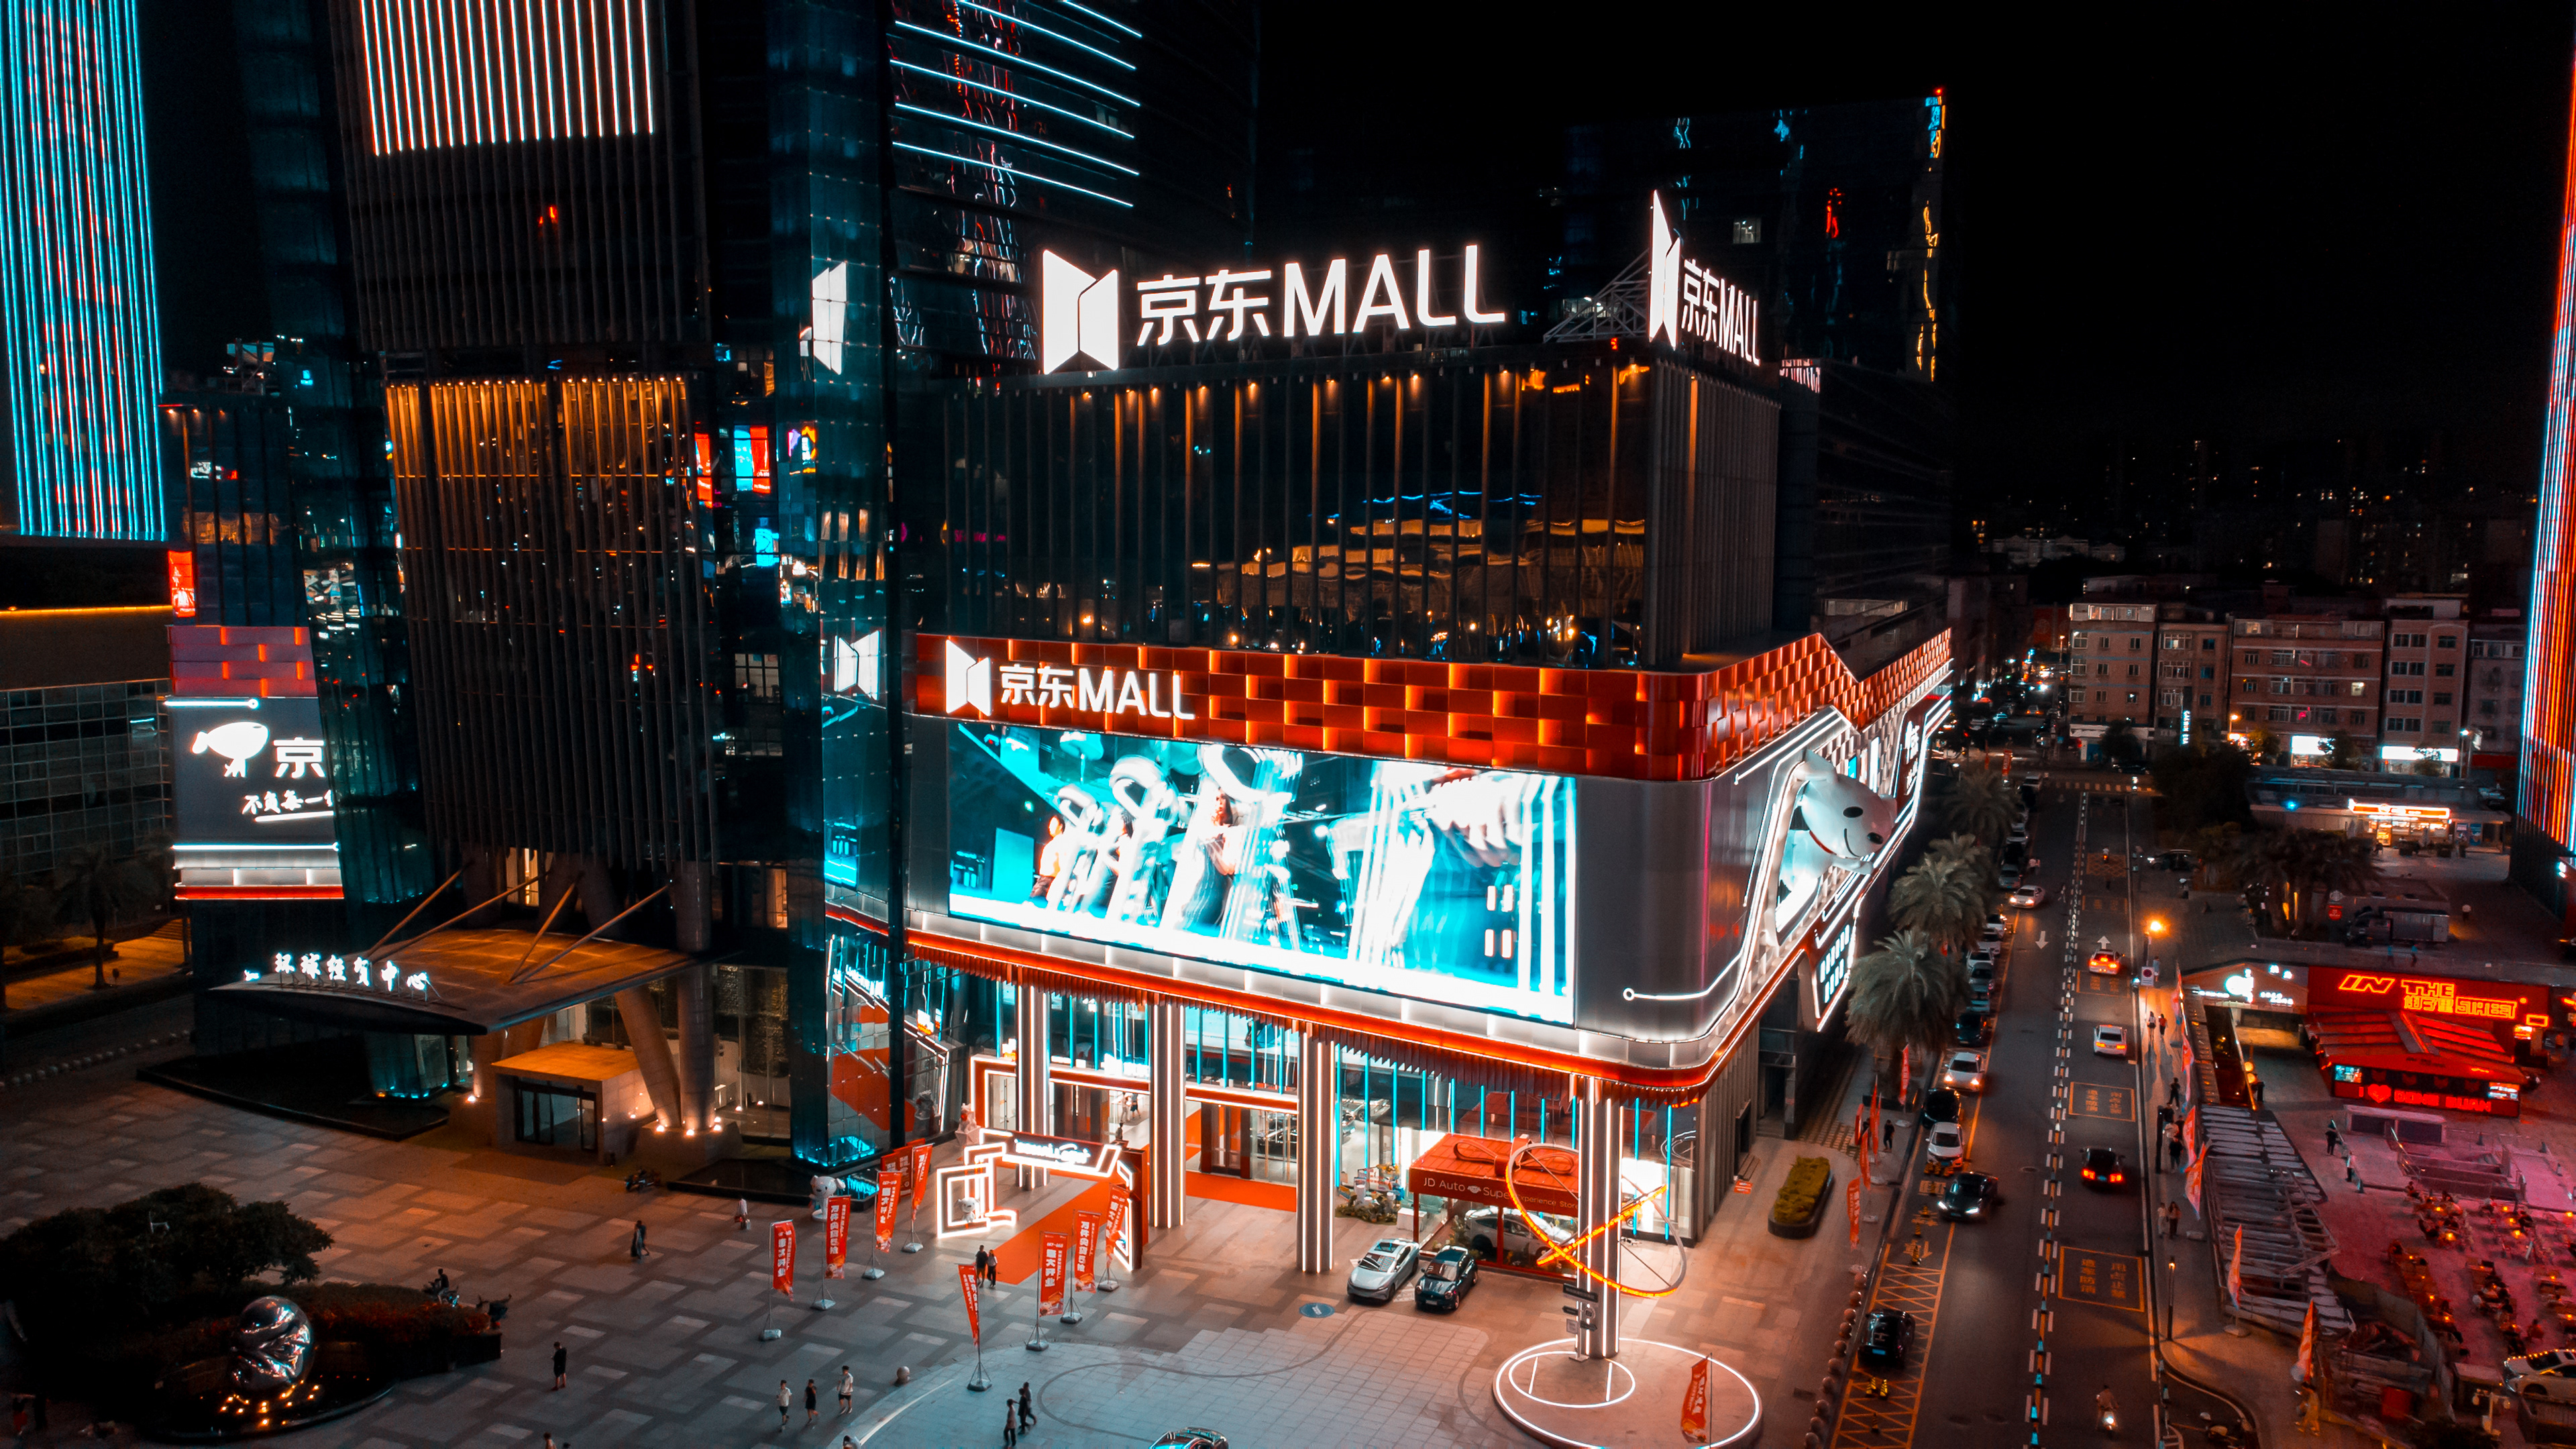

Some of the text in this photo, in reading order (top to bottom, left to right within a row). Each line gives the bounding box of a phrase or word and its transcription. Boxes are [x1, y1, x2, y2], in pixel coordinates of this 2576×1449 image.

[1136, 244, 1505, 346] 京东MALL
[1681, 258, 1761, 367] 京东MALL
[999, 663, 1195, 720] 京东MALL
[272, 737, 326, 779] 京
[2339, 975, 2455, 998] IN THE
[1423, 1177, 1436, 1187] JD
[1439, 1179, 1466, 1192] Auto
[1483, 1187, 1510, 1200] Supe
